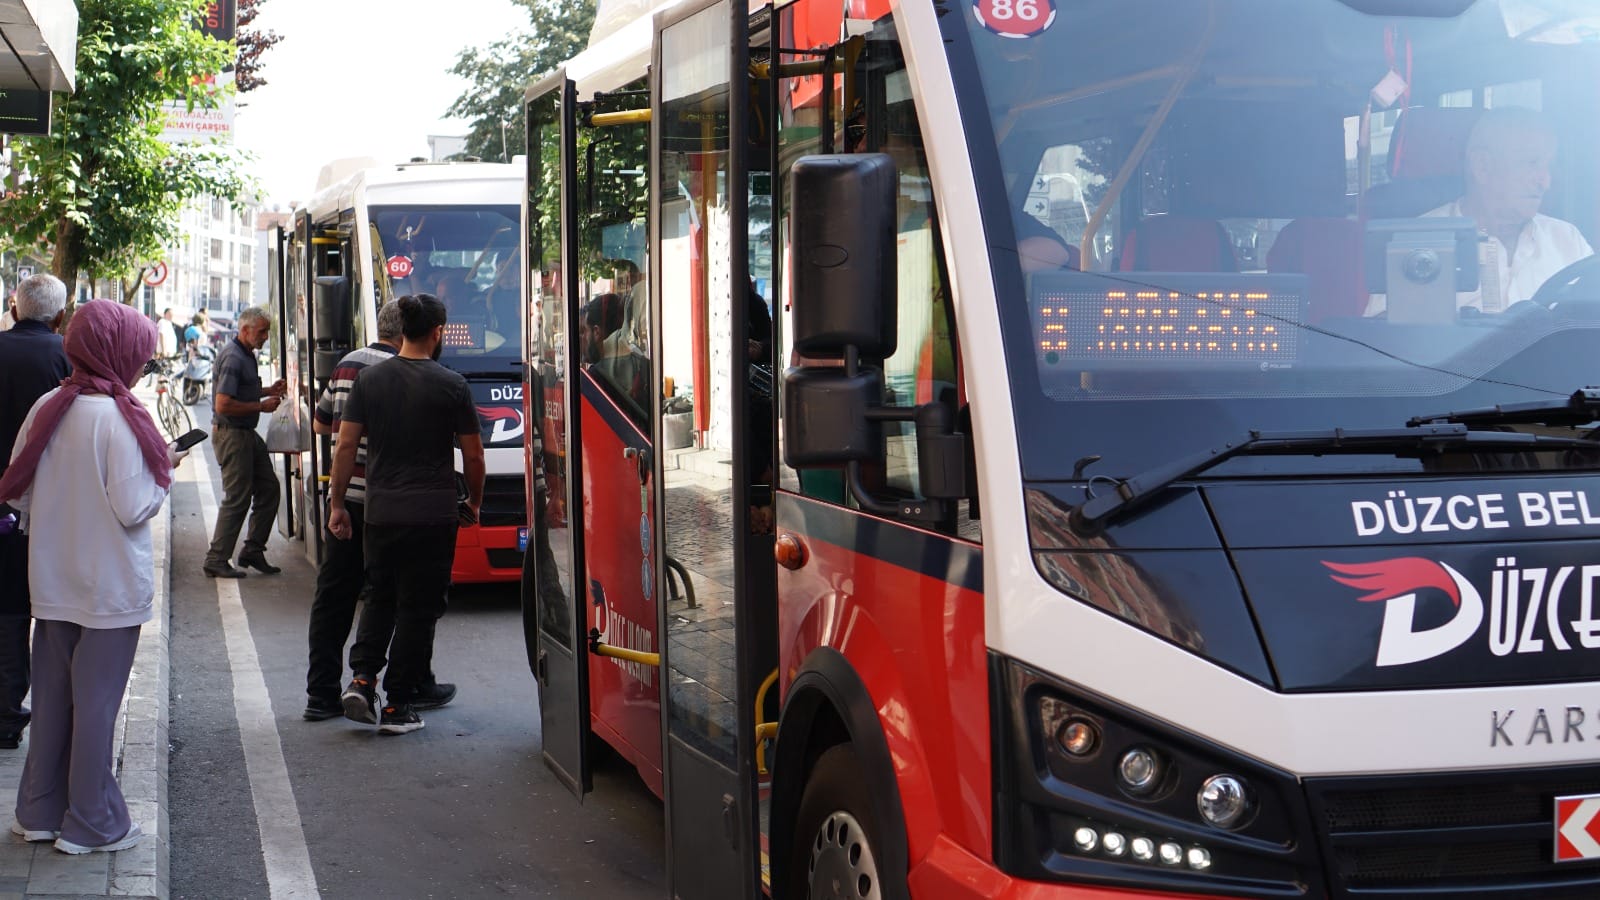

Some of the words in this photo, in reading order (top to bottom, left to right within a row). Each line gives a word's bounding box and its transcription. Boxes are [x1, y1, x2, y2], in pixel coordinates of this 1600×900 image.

[991, 0, 1039, 20] 86
[390, 261, 408, 272] 60
[1352, 490, 1510, 536] DÜZCE
[1517, 491, 1600, 527] BEL
[1490, 705, 1600, 748] KAR
